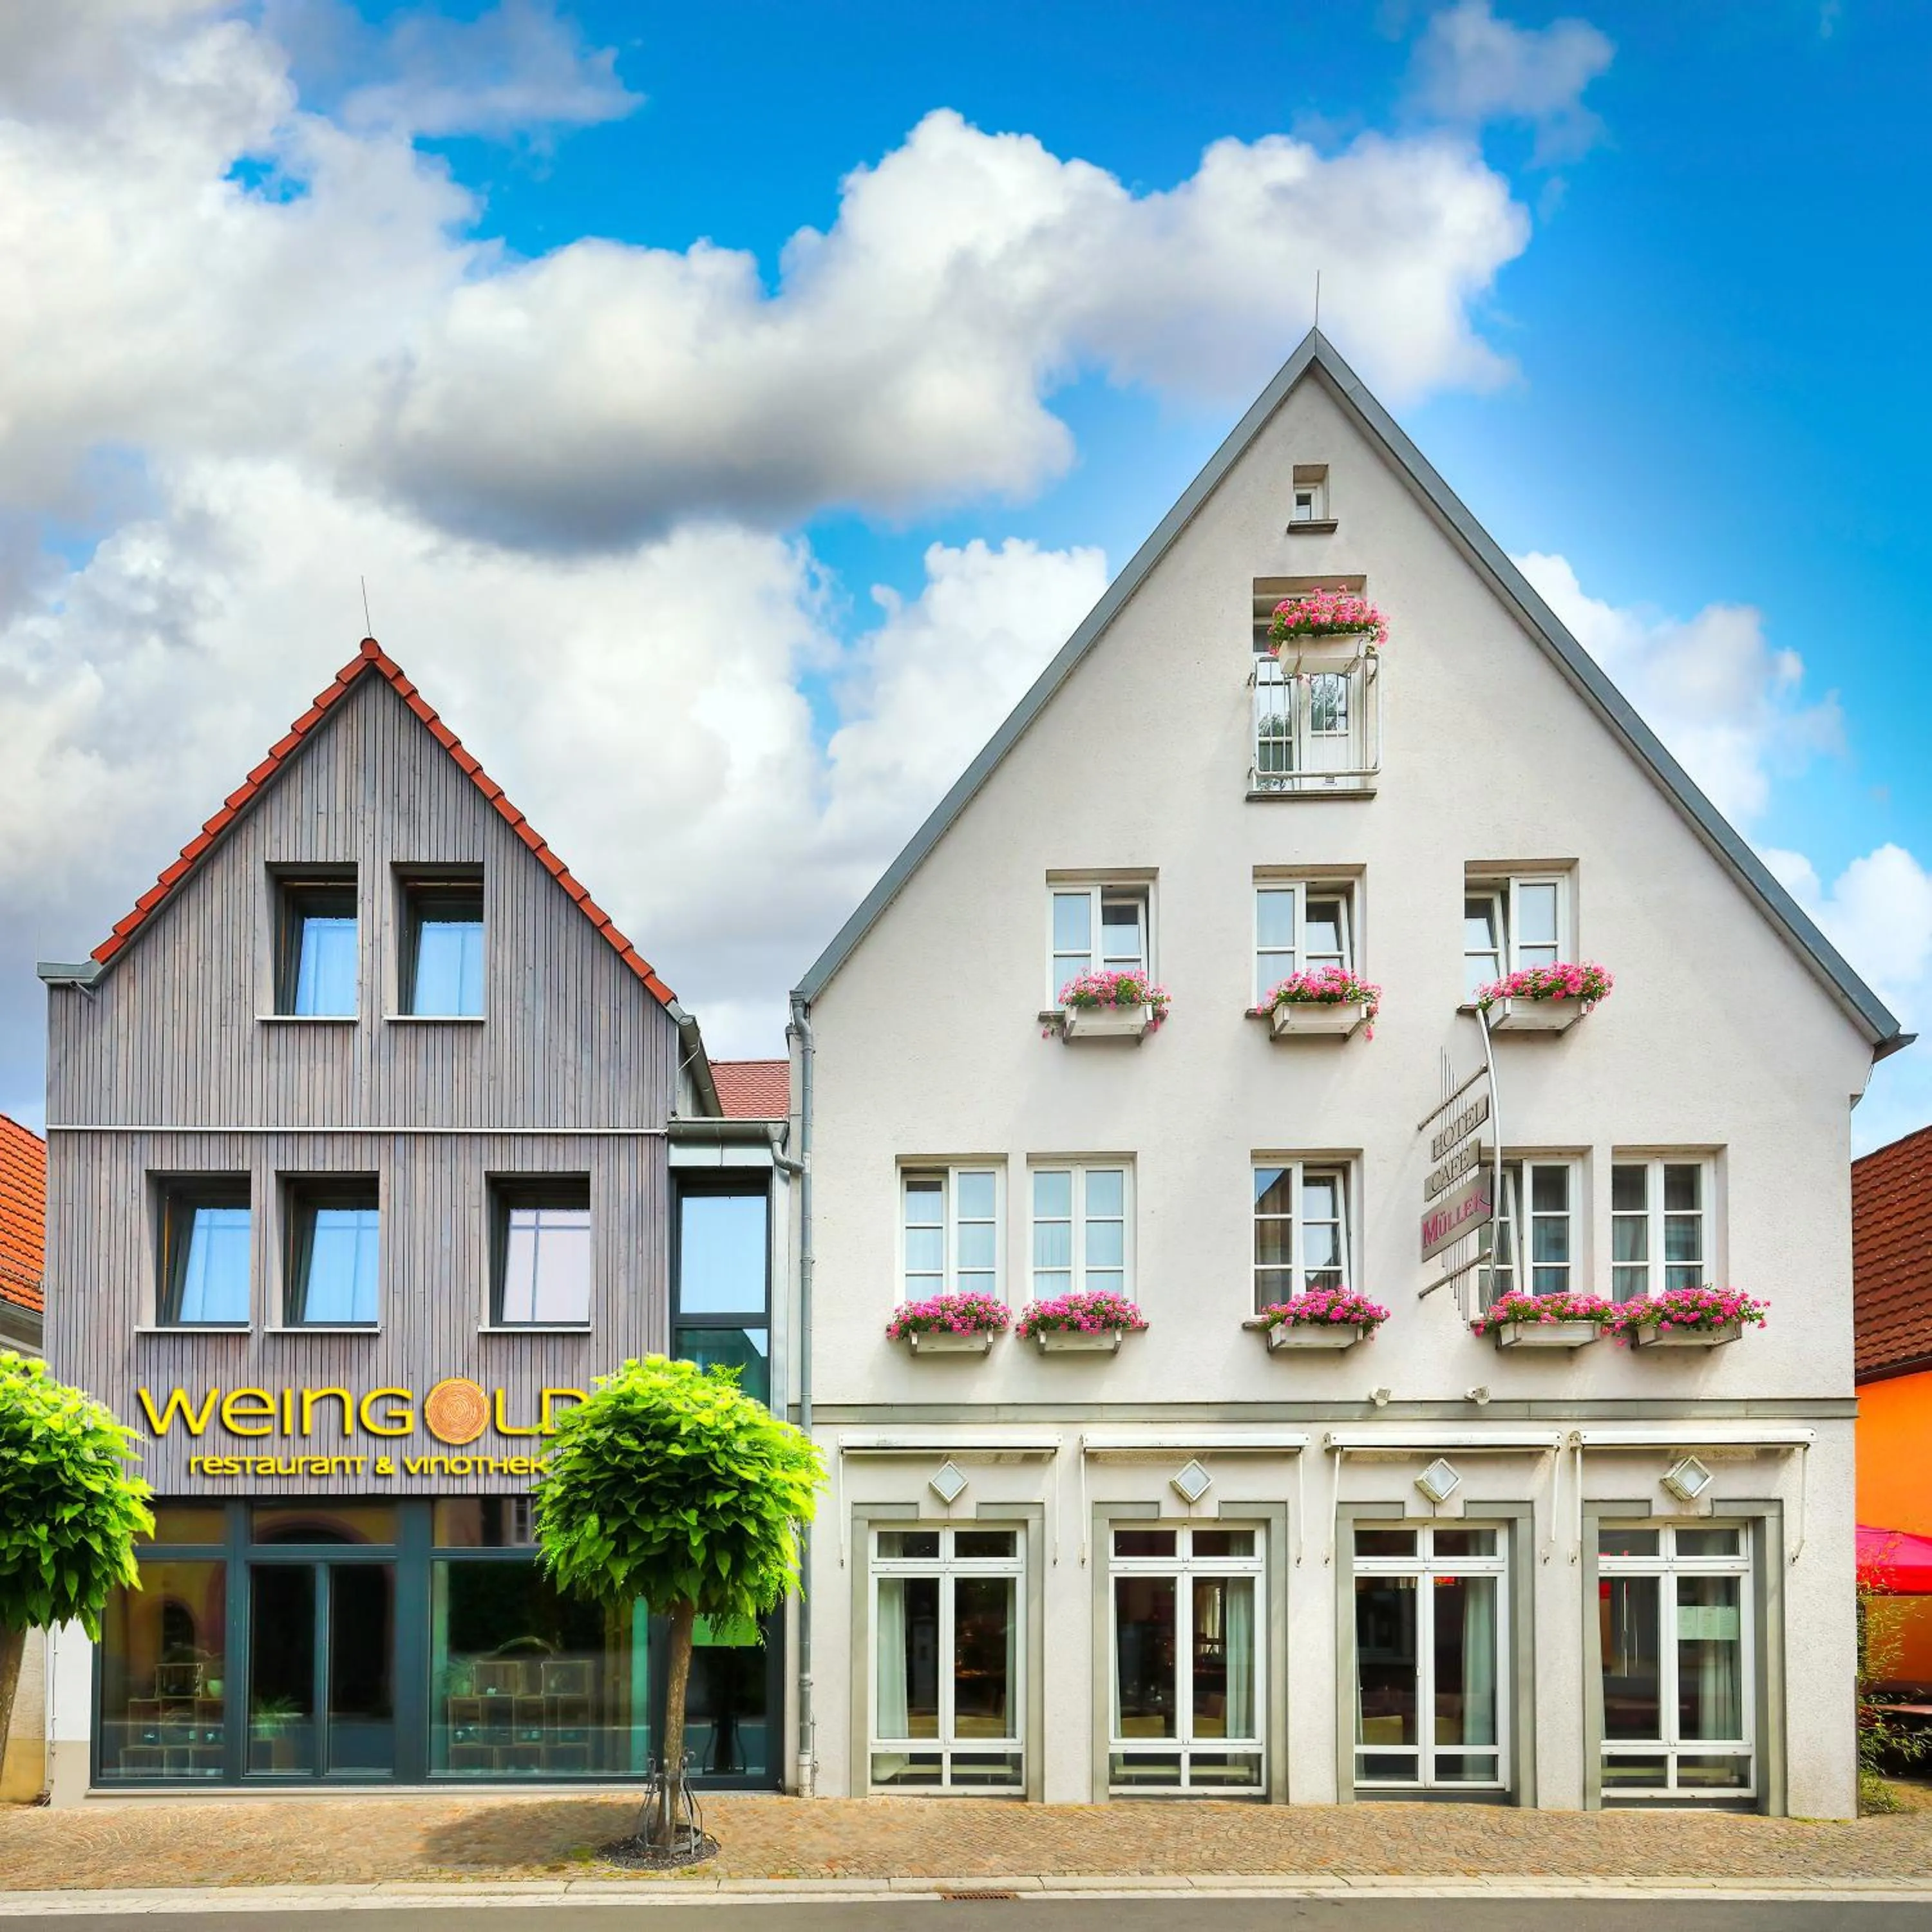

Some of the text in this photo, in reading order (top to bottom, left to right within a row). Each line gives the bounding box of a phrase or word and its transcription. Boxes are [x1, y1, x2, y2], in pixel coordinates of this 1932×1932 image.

[1432, 1102, 1485, 1159] HOTEL
[1432, 1148, 1470, 1192] CAFE
[190, 1455, 367, 1474] restaurant
[375, 1455, 395, 1474] &
